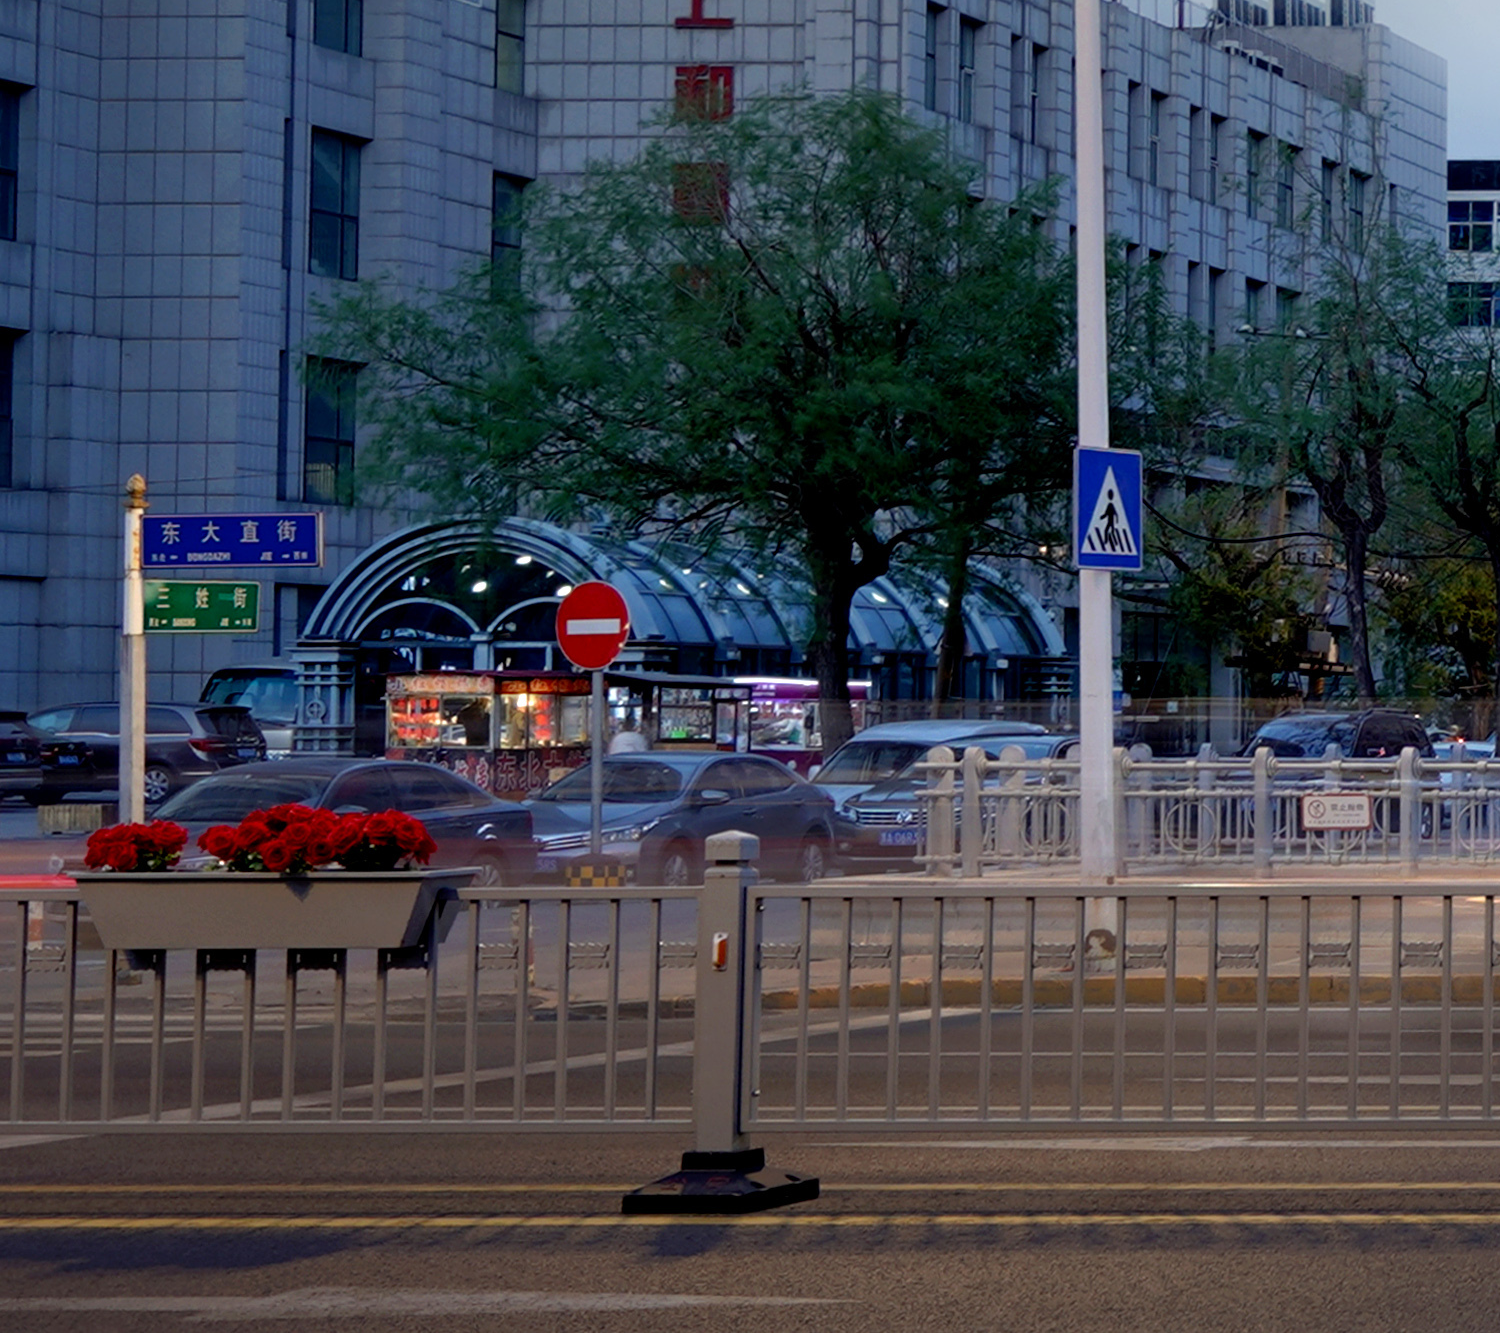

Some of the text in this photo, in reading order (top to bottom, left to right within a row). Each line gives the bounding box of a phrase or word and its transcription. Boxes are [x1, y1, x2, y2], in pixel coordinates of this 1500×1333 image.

[161, 519, 297, 545] 东大直街
[156, 586, 248, 609] 三姓街
